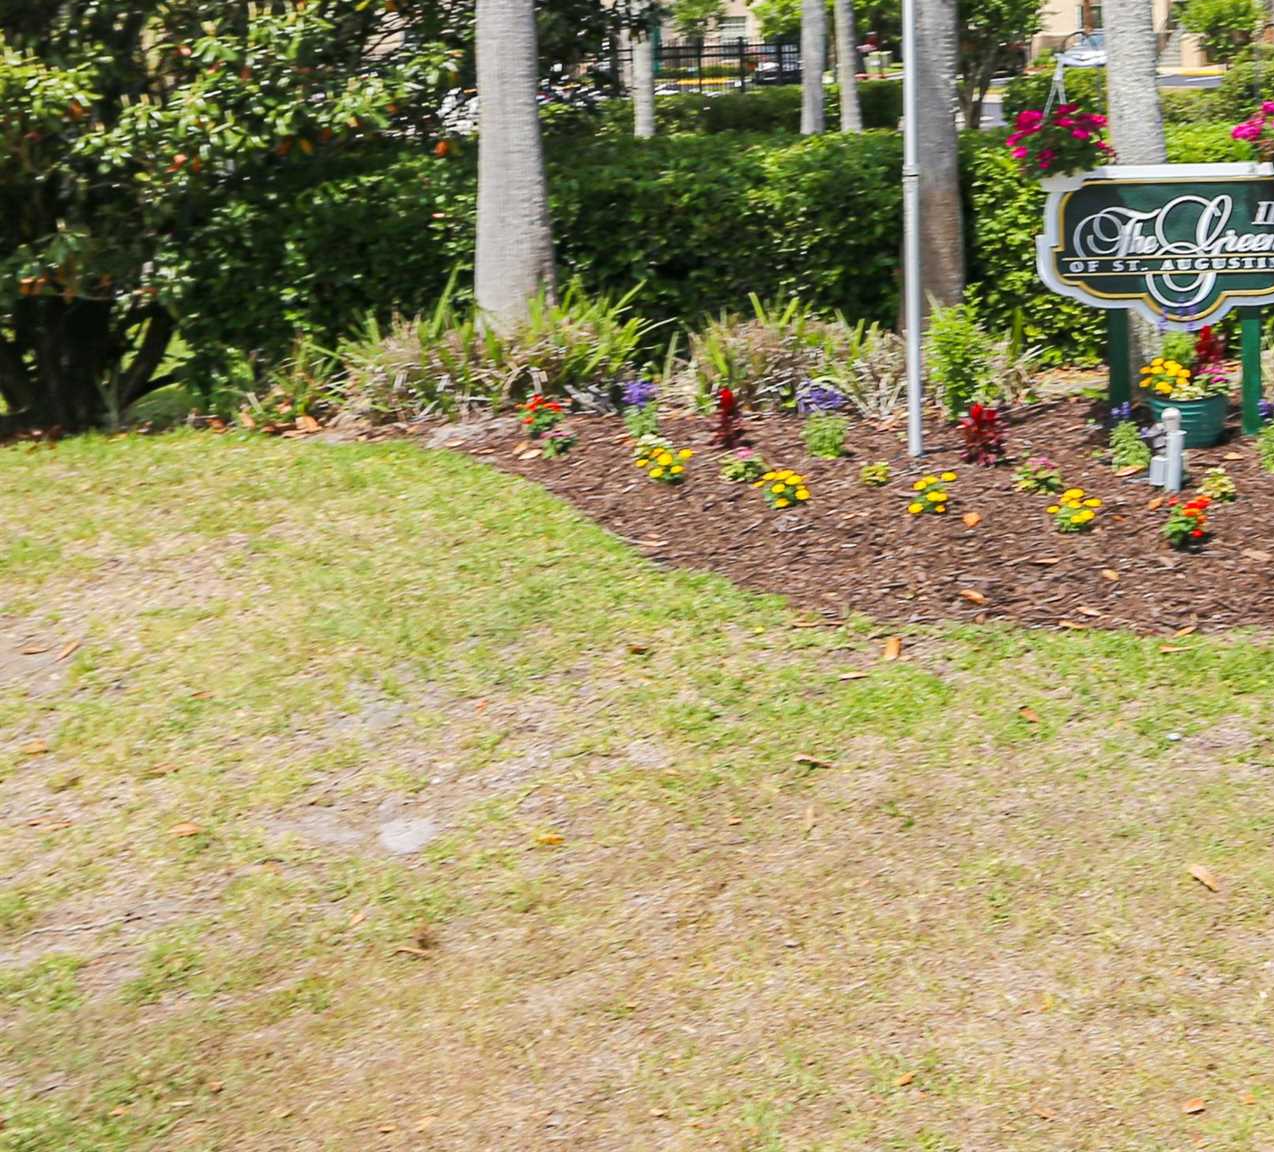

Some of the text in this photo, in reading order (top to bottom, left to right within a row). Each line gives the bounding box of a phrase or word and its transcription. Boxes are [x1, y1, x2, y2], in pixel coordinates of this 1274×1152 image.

[1073, 206, 1162, 258] The
[1069, 260, 1100, 273] OF
[1112, 259, 1149, 272] ST.
